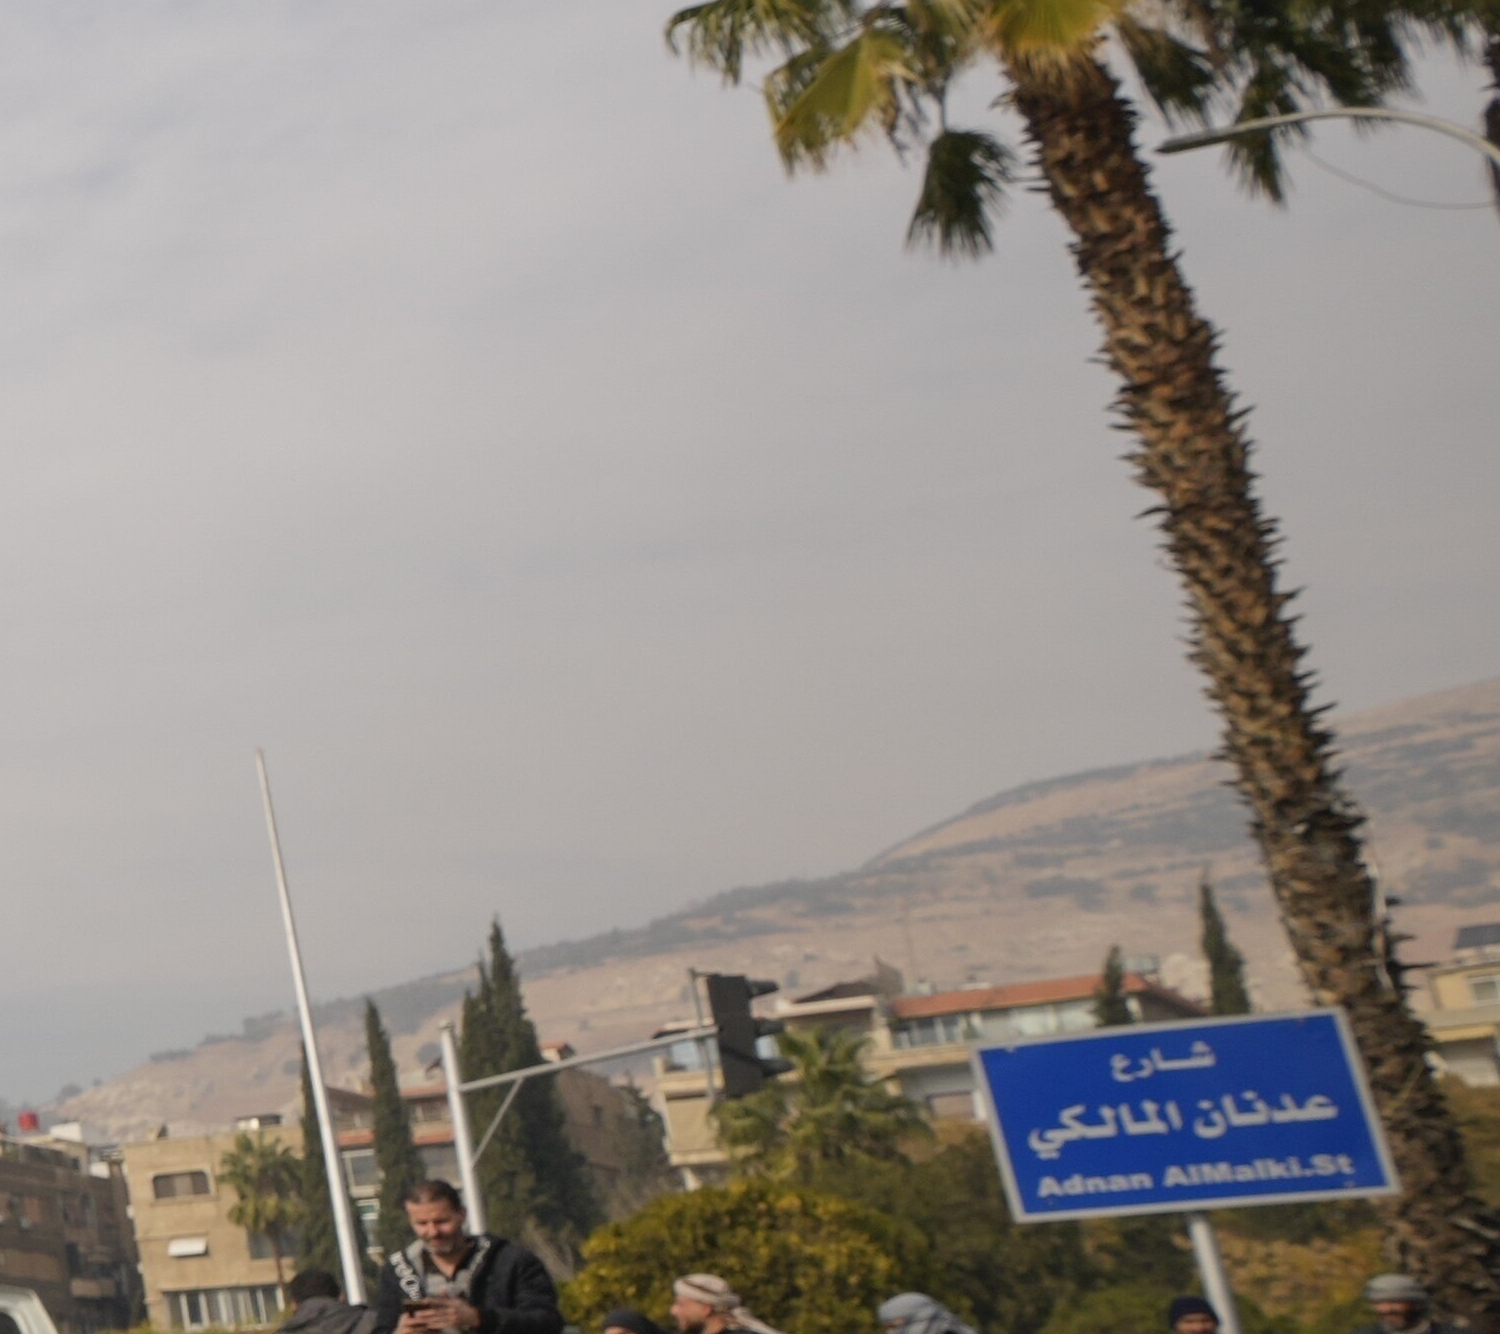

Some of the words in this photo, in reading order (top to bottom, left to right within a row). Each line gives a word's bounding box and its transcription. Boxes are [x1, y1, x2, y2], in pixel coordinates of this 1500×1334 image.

[1110, 1041, 1216, 1082] شارع
[1027, 1099, 1183, 1160] المالكي
[1193, 1090, 1339, 1139] عدنان
[1037, 1172, 1154, 1198] Adnan
[1163, 1153, 1356, 1188] AlMalki.St
